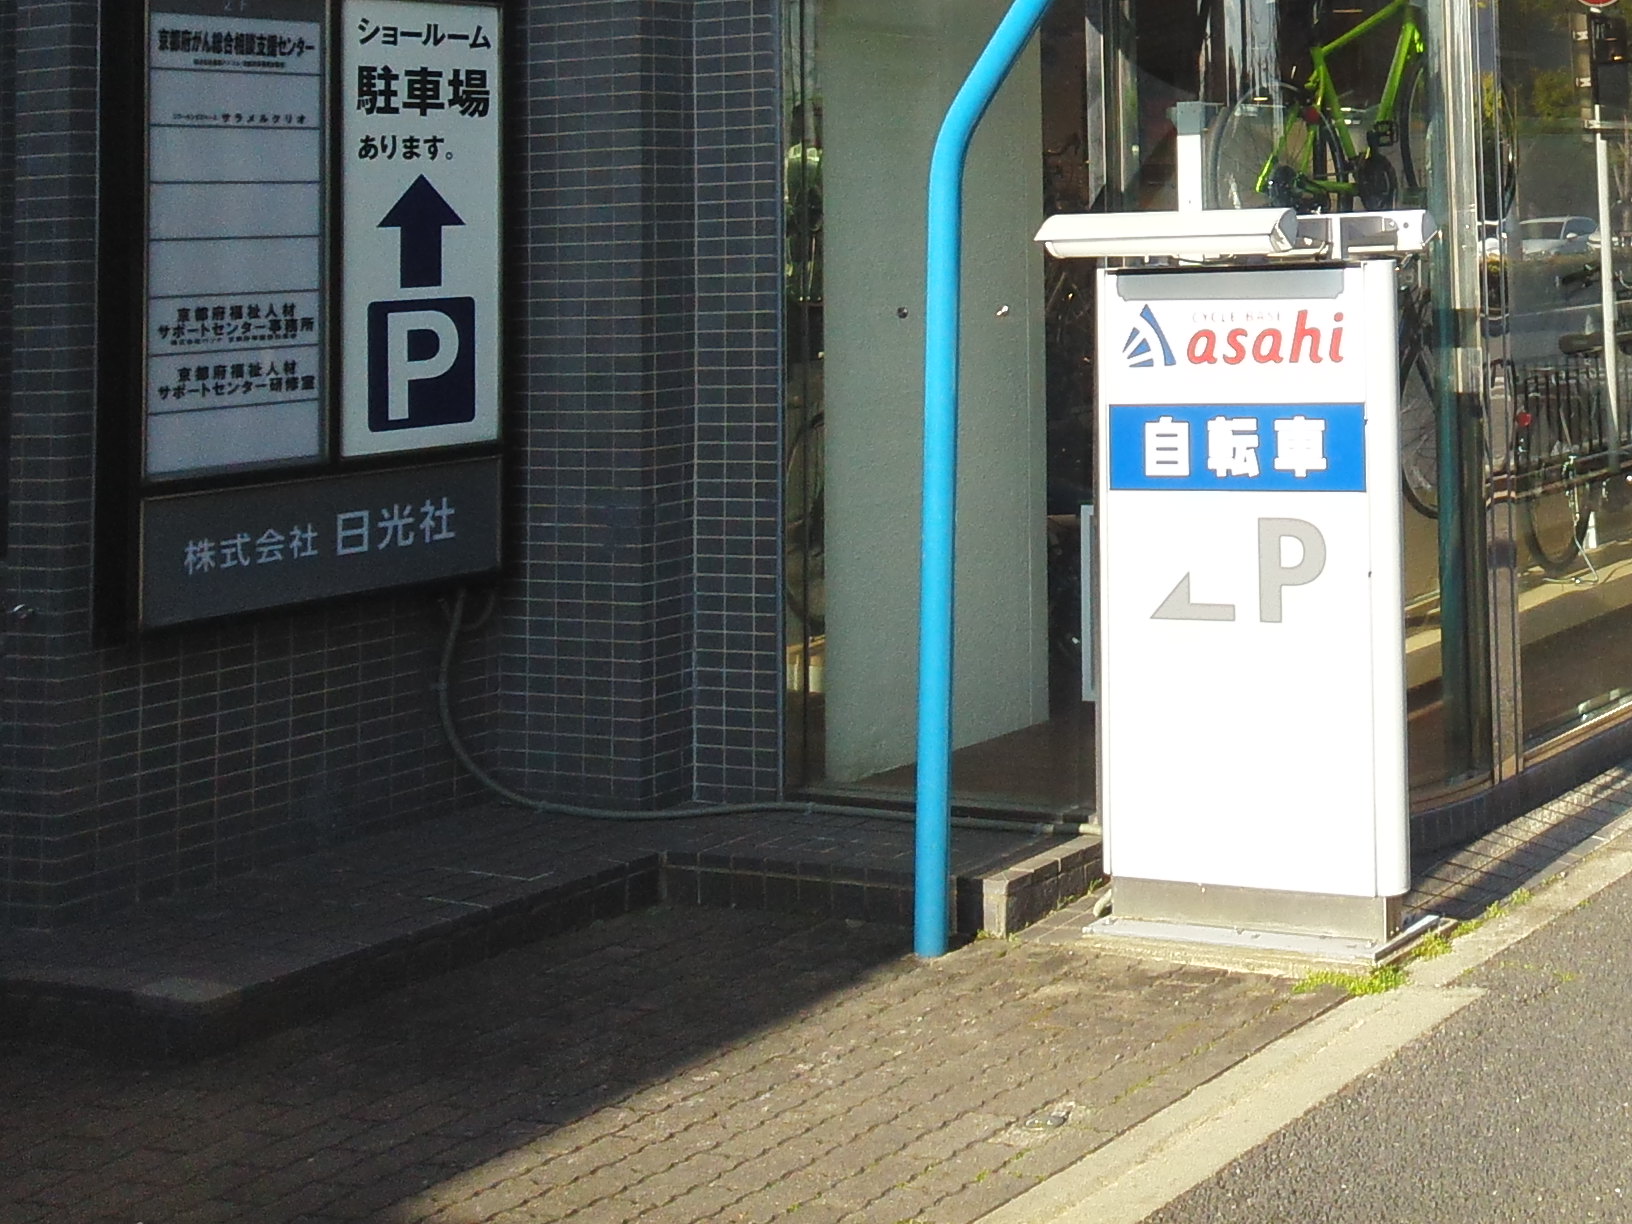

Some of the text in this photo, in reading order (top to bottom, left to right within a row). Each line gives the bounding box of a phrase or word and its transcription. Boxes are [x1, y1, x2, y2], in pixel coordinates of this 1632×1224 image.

[358, 17, 492, 50] ショールーム
[356, 64, 491, 118] 駐車場
[358, 134, 454, 161] あります。
[387, 310, 460, 421] P
[1186, 309, 1345, 366] asahi
[1143, 414, 1329, 479] 自転車
[183, 496, 456, 575] 株式会社 日光社
[1257, 517, 1327, 624] P
